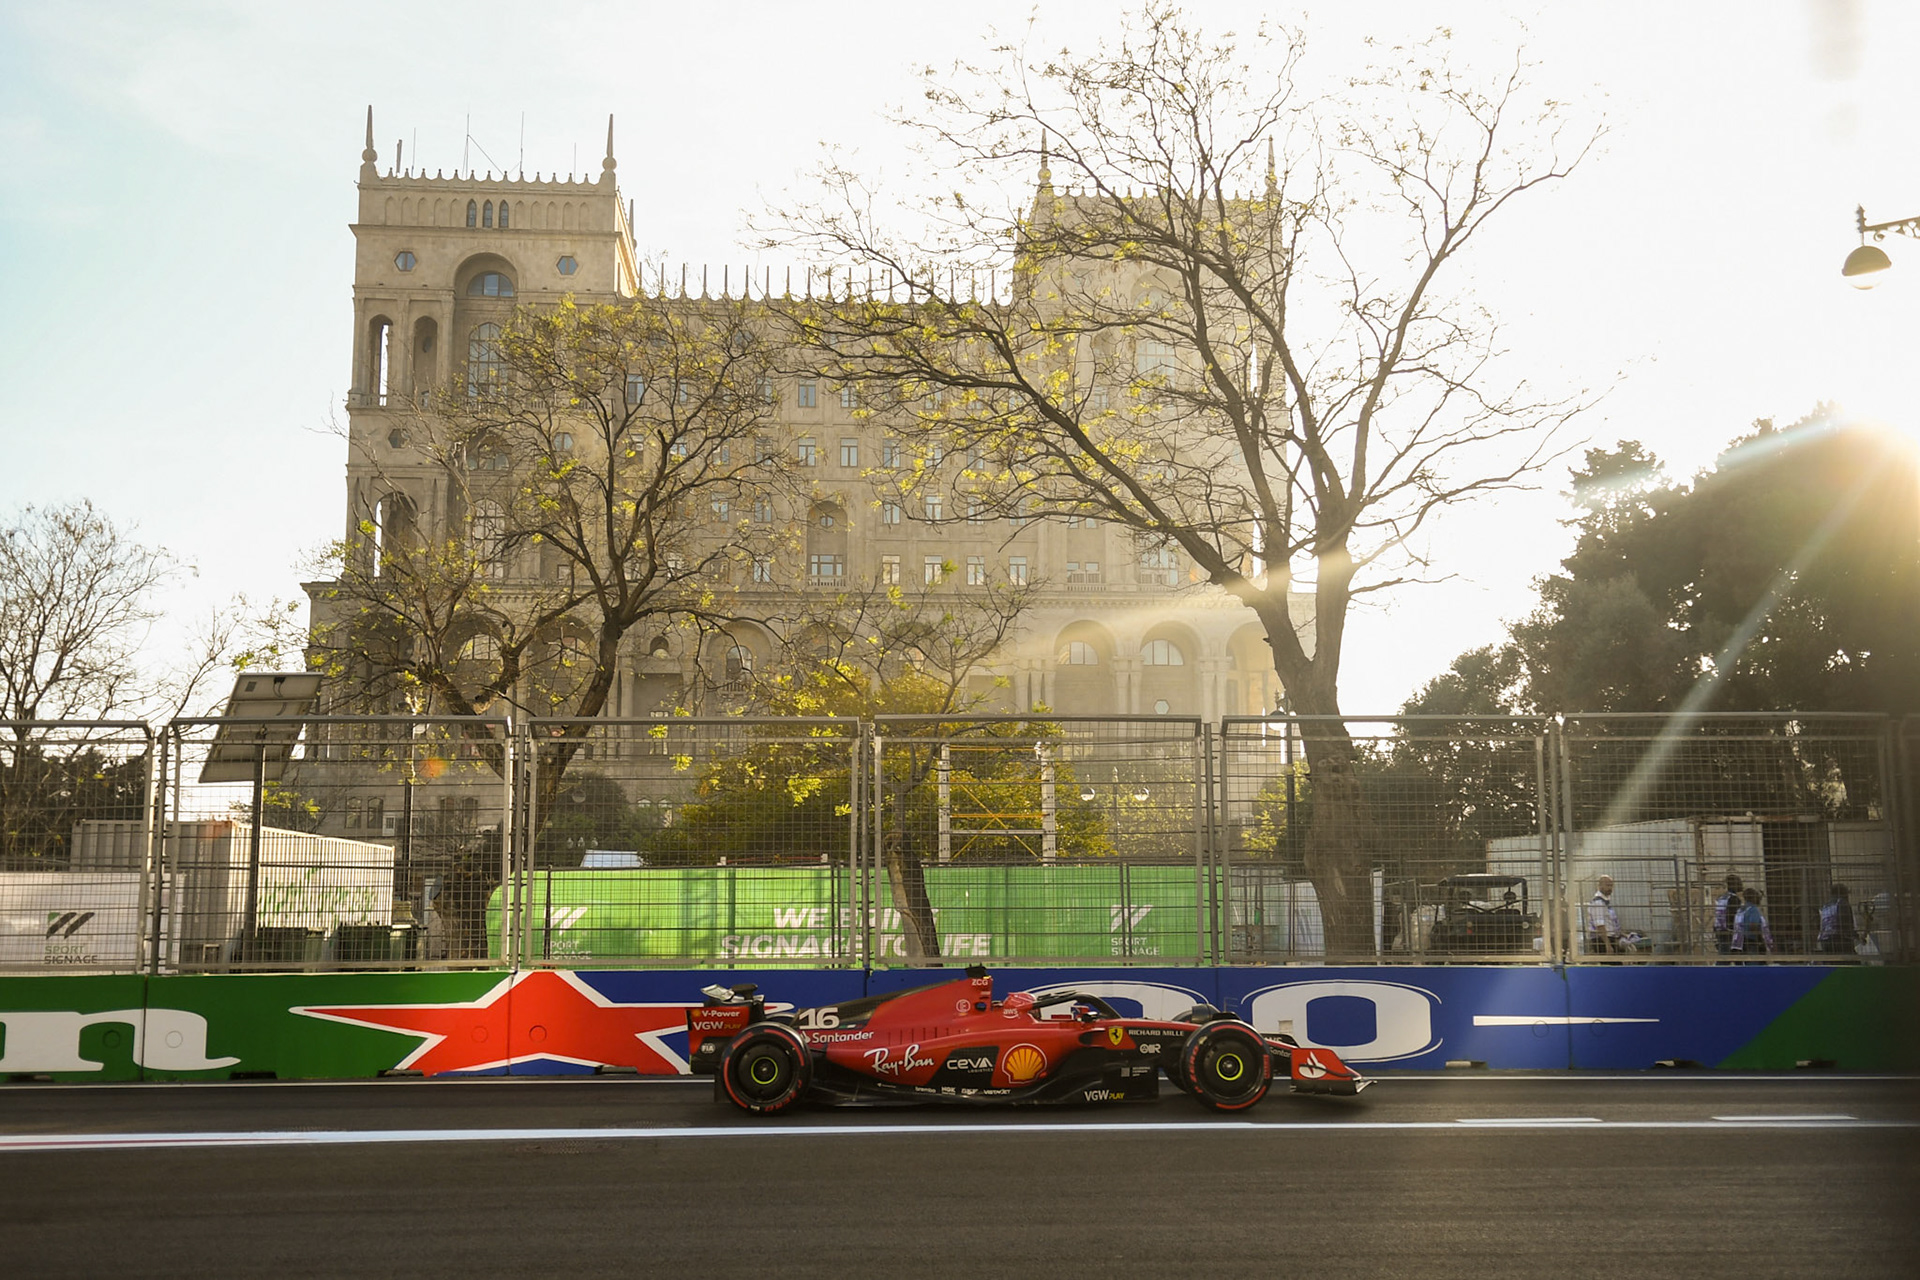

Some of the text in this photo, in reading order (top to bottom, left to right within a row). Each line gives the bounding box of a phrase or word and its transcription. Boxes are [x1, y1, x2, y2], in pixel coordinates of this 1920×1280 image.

[774, 908, 828, 929] WE
[44, 945, 85, 954] SPORT
[550, 941, 579, 950] PORT
[940, 933, 992, 957] IFE
[44, 955, 98, 965] SIGNAGE
[971, 978, 989, 986] ZCG
[701, 1009, 740, 1017] V-Power
[799, 1006, 840, 1030] 16
[692, 1021, 724, 1031] VGW
[812, 1031, 874, 1044] Santander
[1084, 1090, 1125, 1101] VGW PLAY
